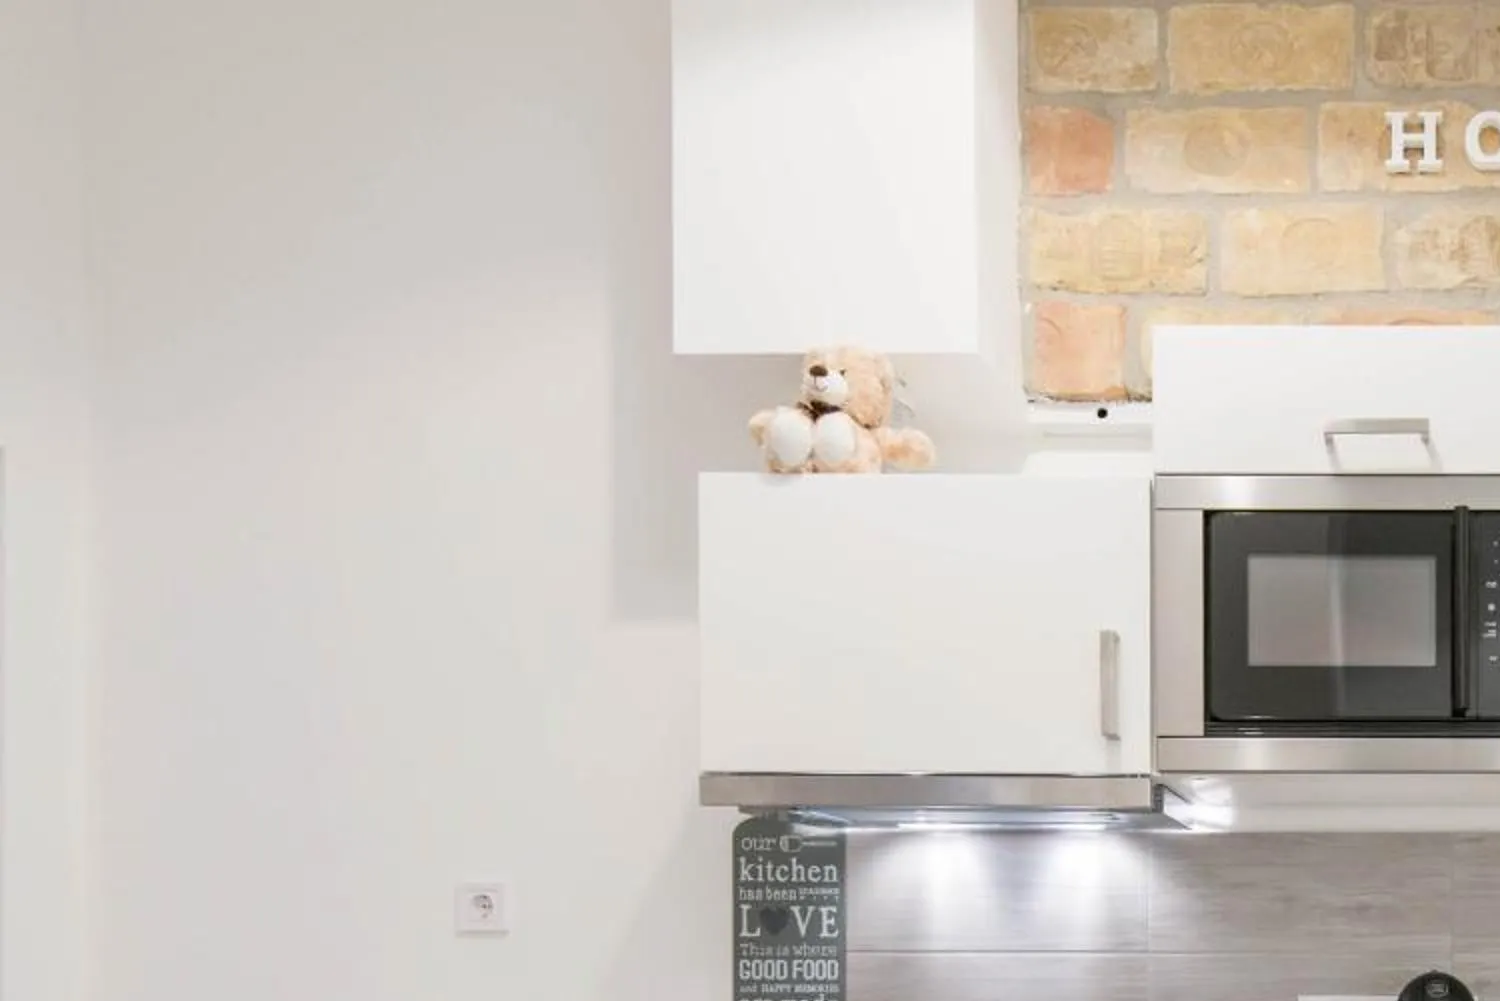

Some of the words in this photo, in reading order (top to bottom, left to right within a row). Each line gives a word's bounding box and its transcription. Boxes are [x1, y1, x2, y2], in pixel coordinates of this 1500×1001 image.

[741, 837, 776, 851] our
[739, 855, 839, 882] kitchen
[739, 885, 763, 901] has
[765, 885, 797, 901] been
[739, 943, 773, 957] This
[792, 942, 837, 957] where
[739, 959, 789, 980] GOOD
[791, 959, 839, 980] FOOD
